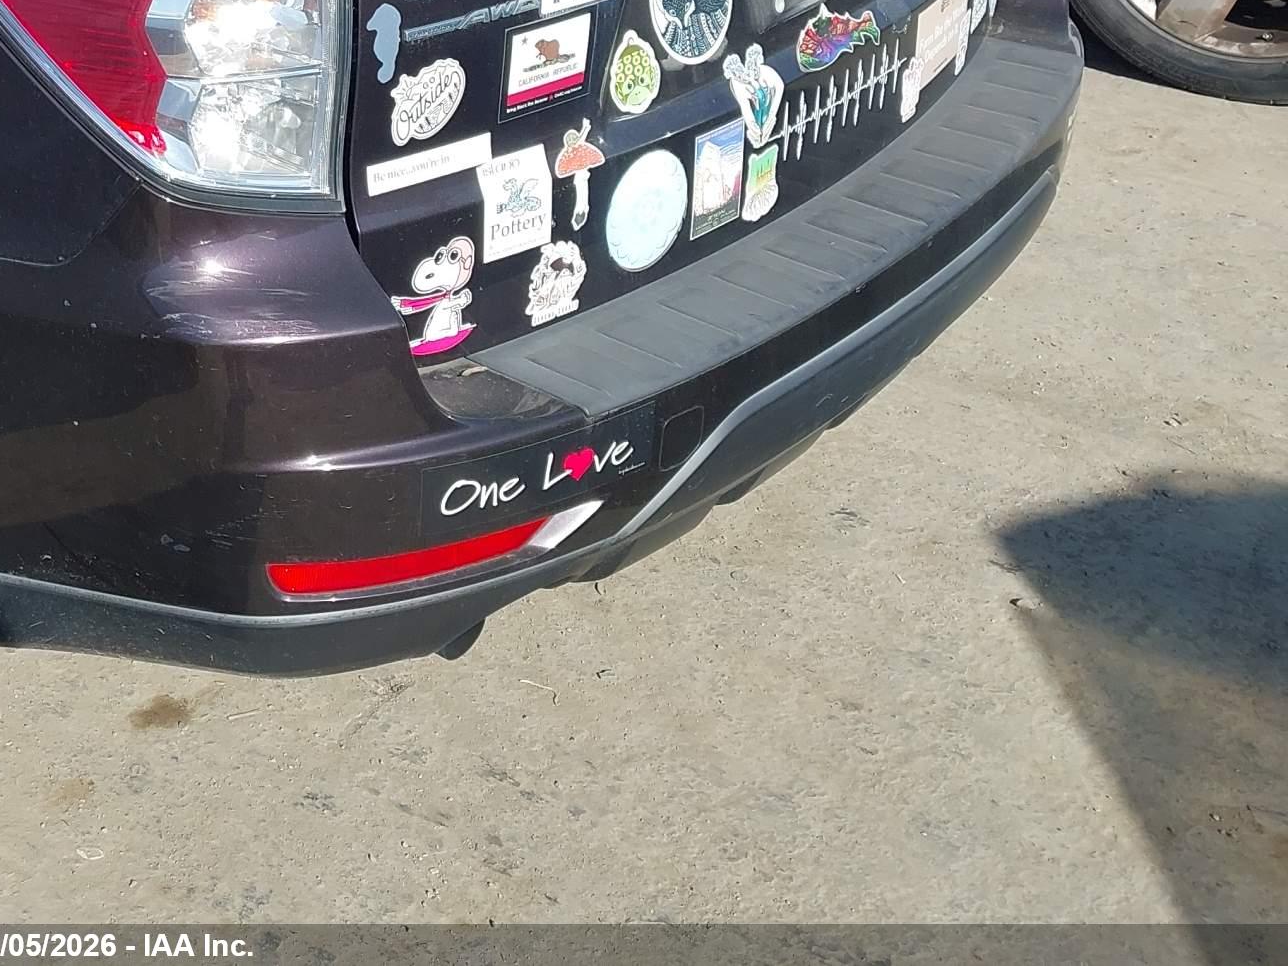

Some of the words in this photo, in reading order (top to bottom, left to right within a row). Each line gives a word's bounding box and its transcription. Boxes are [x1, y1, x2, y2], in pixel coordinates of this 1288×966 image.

[518, 71, 549, 87] CALIFORNIA
[552, 62, 578, 76] REPUBLIC
[396, 70, 453, 141] Outside
[491, 212, 547, 241] Pottery
[440, 477, 525, 516] One
